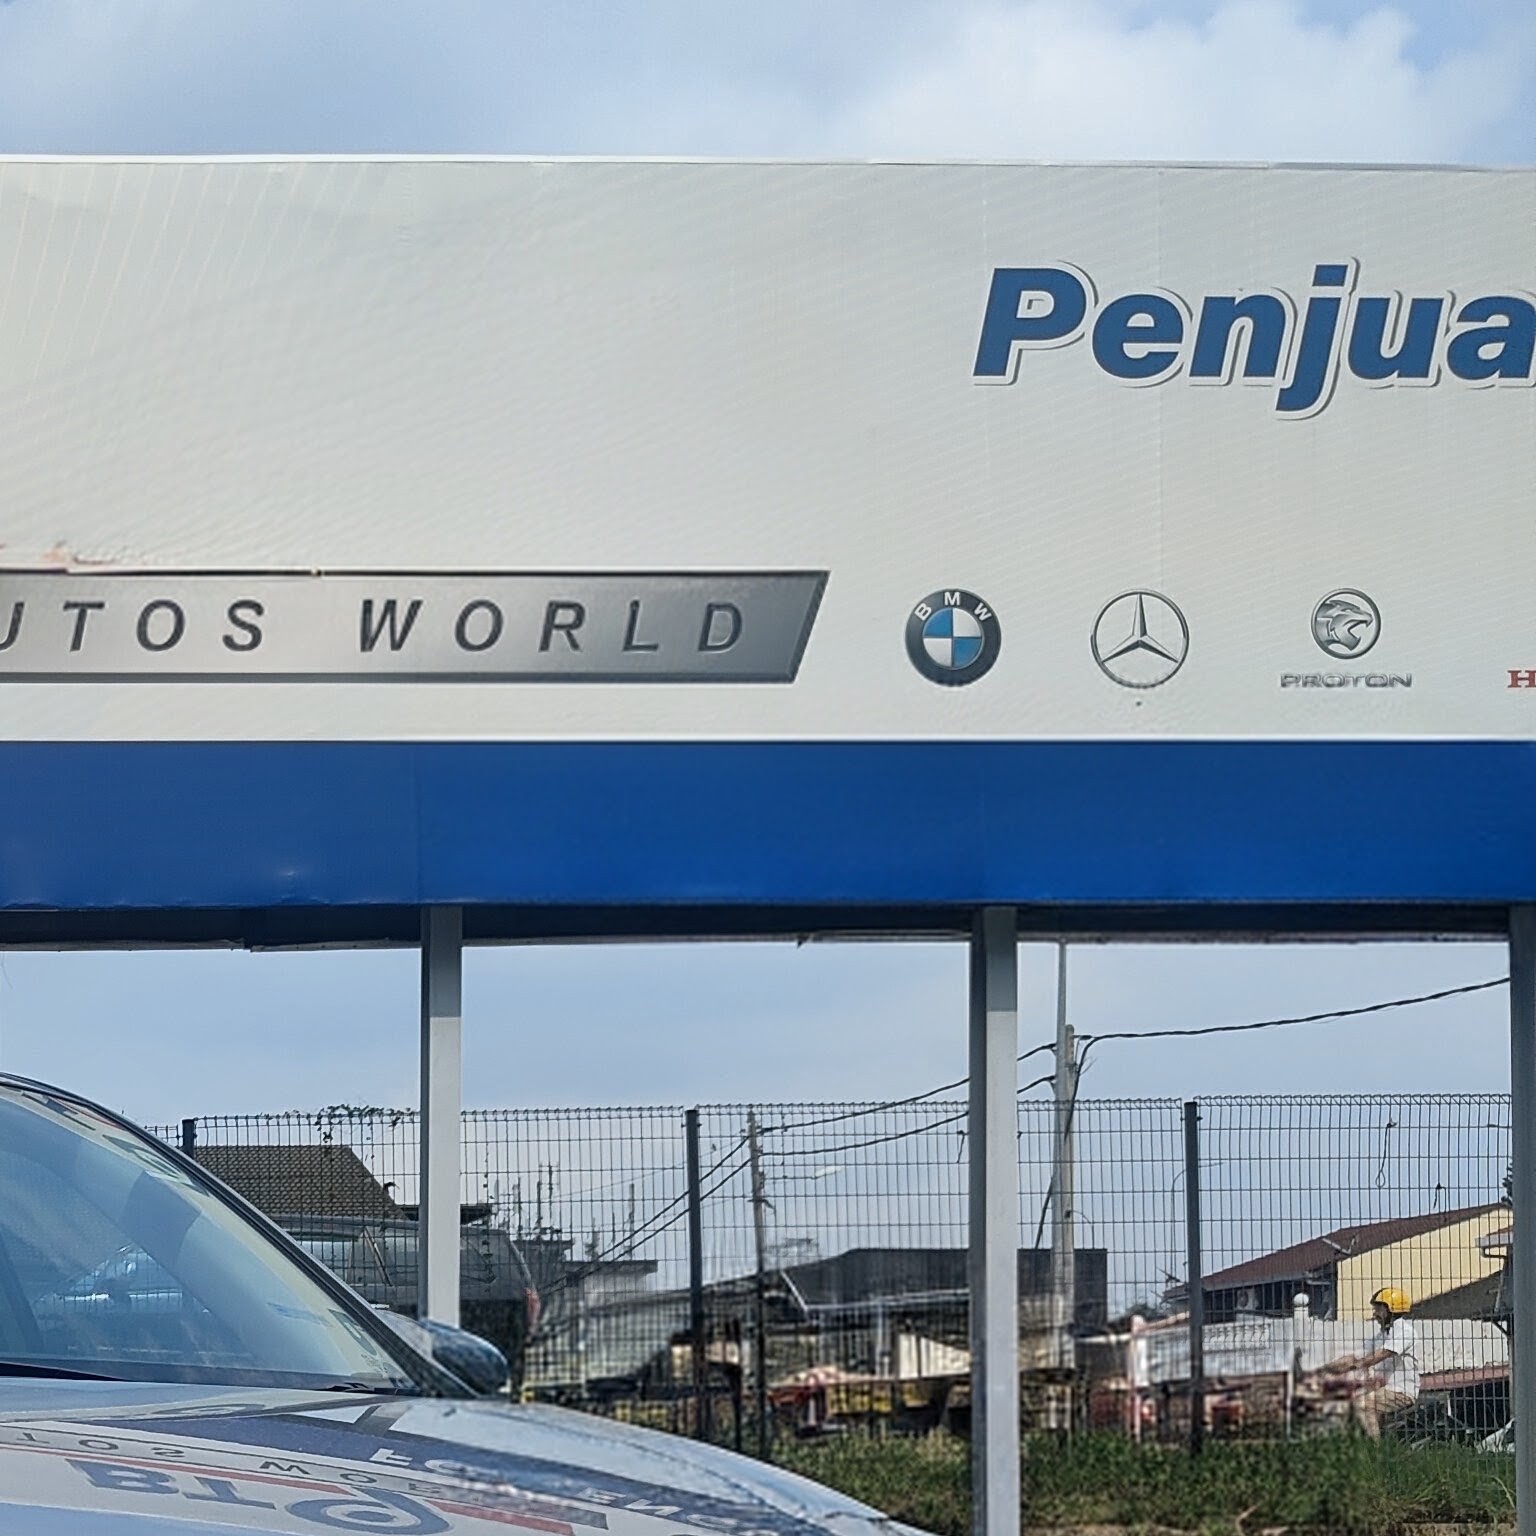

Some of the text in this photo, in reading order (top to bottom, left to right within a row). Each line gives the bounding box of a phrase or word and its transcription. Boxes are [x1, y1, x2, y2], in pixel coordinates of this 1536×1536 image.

[972, 258, 1536, 420] Penjua
[359, 600, 745, 655] WORLD
[915, 591, 993, 622] BMW
[1280, 672, 1413, 689] PROTON
